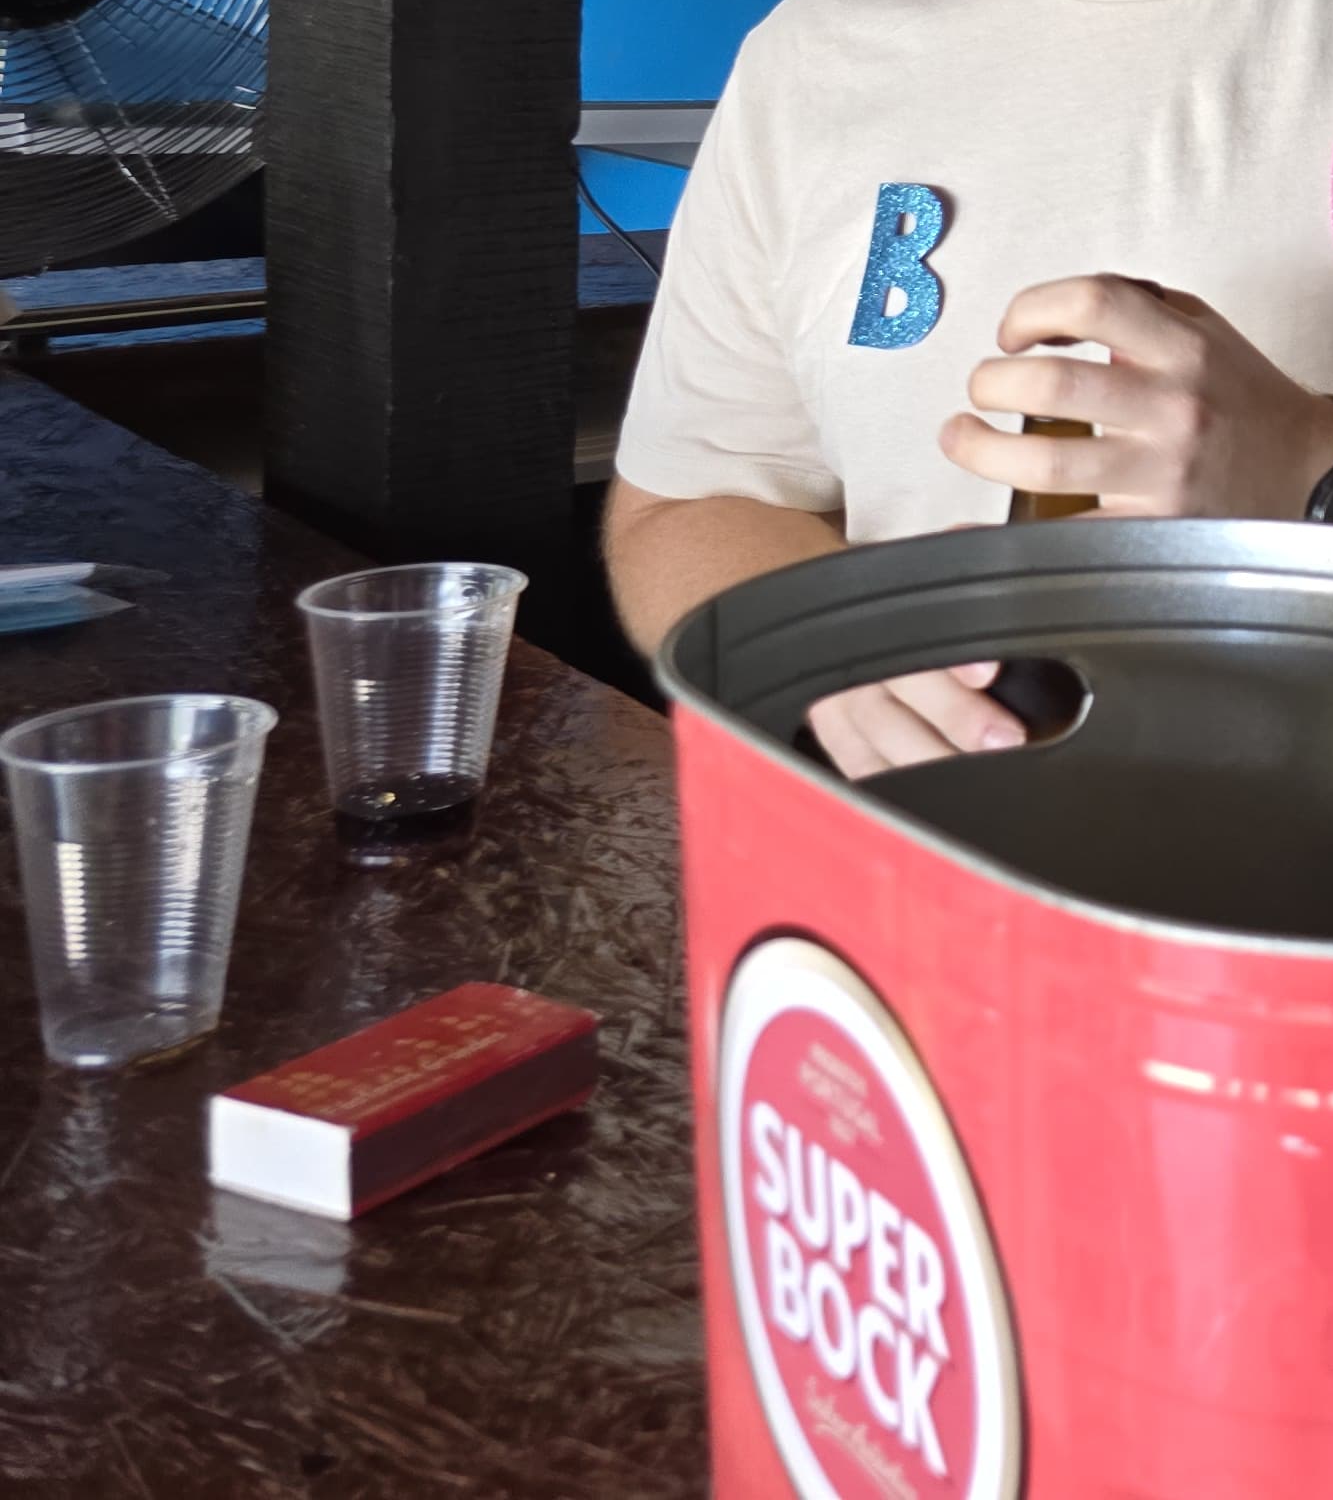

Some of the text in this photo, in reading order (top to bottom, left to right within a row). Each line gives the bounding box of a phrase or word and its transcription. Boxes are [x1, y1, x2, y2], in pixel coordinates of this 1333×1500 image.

[847, 180, 946, 350] B
[750, 1100, 950, 1360] SUPER
[764, 1217, 948, 1478] BOCK
